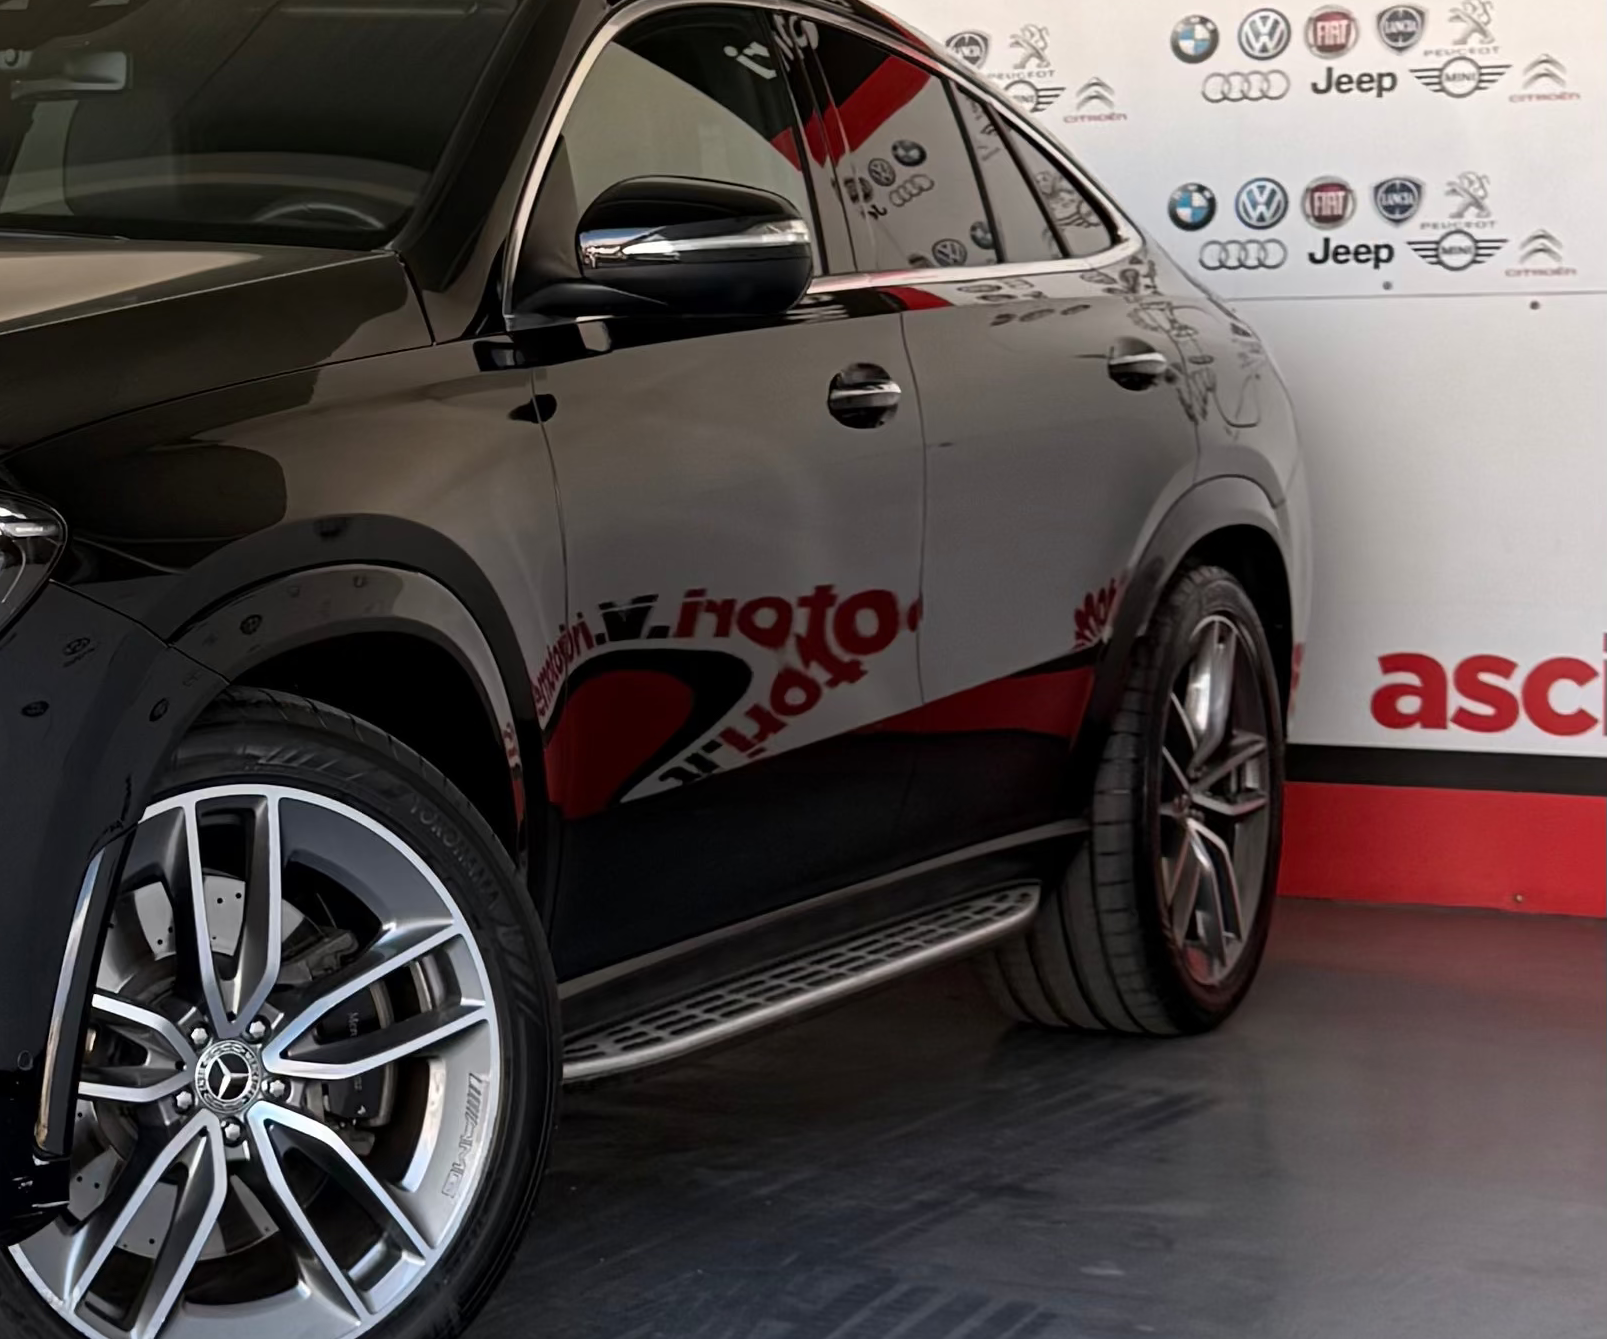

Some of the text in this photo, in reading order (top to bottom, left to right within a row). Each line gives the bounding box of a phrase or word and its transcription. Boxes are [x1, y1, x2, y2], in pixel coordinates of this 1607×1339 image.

[1316, 20, 1349, 46] FIAT
[1311, 66, 1398, 98] Jeep
[1445, 72, 1476, 83] MINI
[1313, 191, 1346, 216] FIAT
[1308, 237, 1395, 270] Jeep
[1441, 245, 1473, 256] MINI
[1370, 632, 1607, 737] asc
